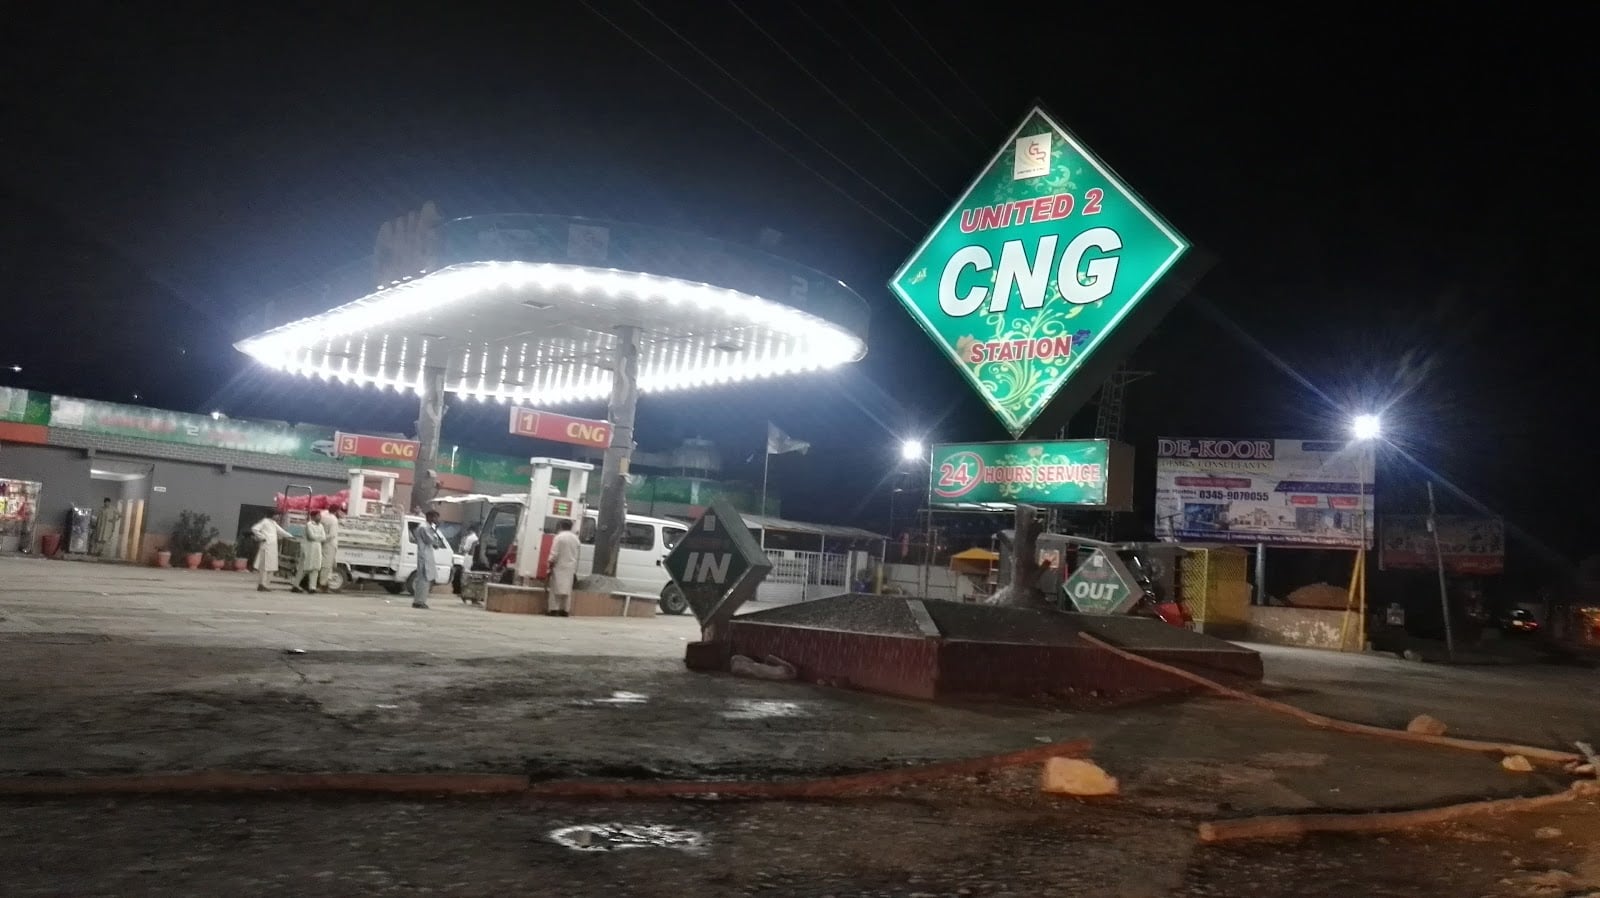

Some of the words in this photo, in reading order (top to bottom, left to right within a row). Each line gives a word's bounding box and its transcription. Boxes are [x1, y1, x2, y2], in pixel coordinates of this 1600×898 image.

[960, 193, 1074, 232] UNITED
[1083, 187, 1104, 217] 2
[937, 227, 1123, 318] CNG
[969, 335, 1073, 364] STATION
[523, 413, 534, 432] 1
[566, 421, 606, 443] CNG
[343, 438, 354, 452] 3
[380, 441, 415, 459] CNG
[1158, 439, 1272, 459] DE-KOOR
[938, 462, 969, 487] 24
[983, 464, 1033, 483] HOURS
[1037, 463, 1101, 483] SERVICE
[682, 551, 732, 584] IN
[1074, 581, 1119, 601] OUT
